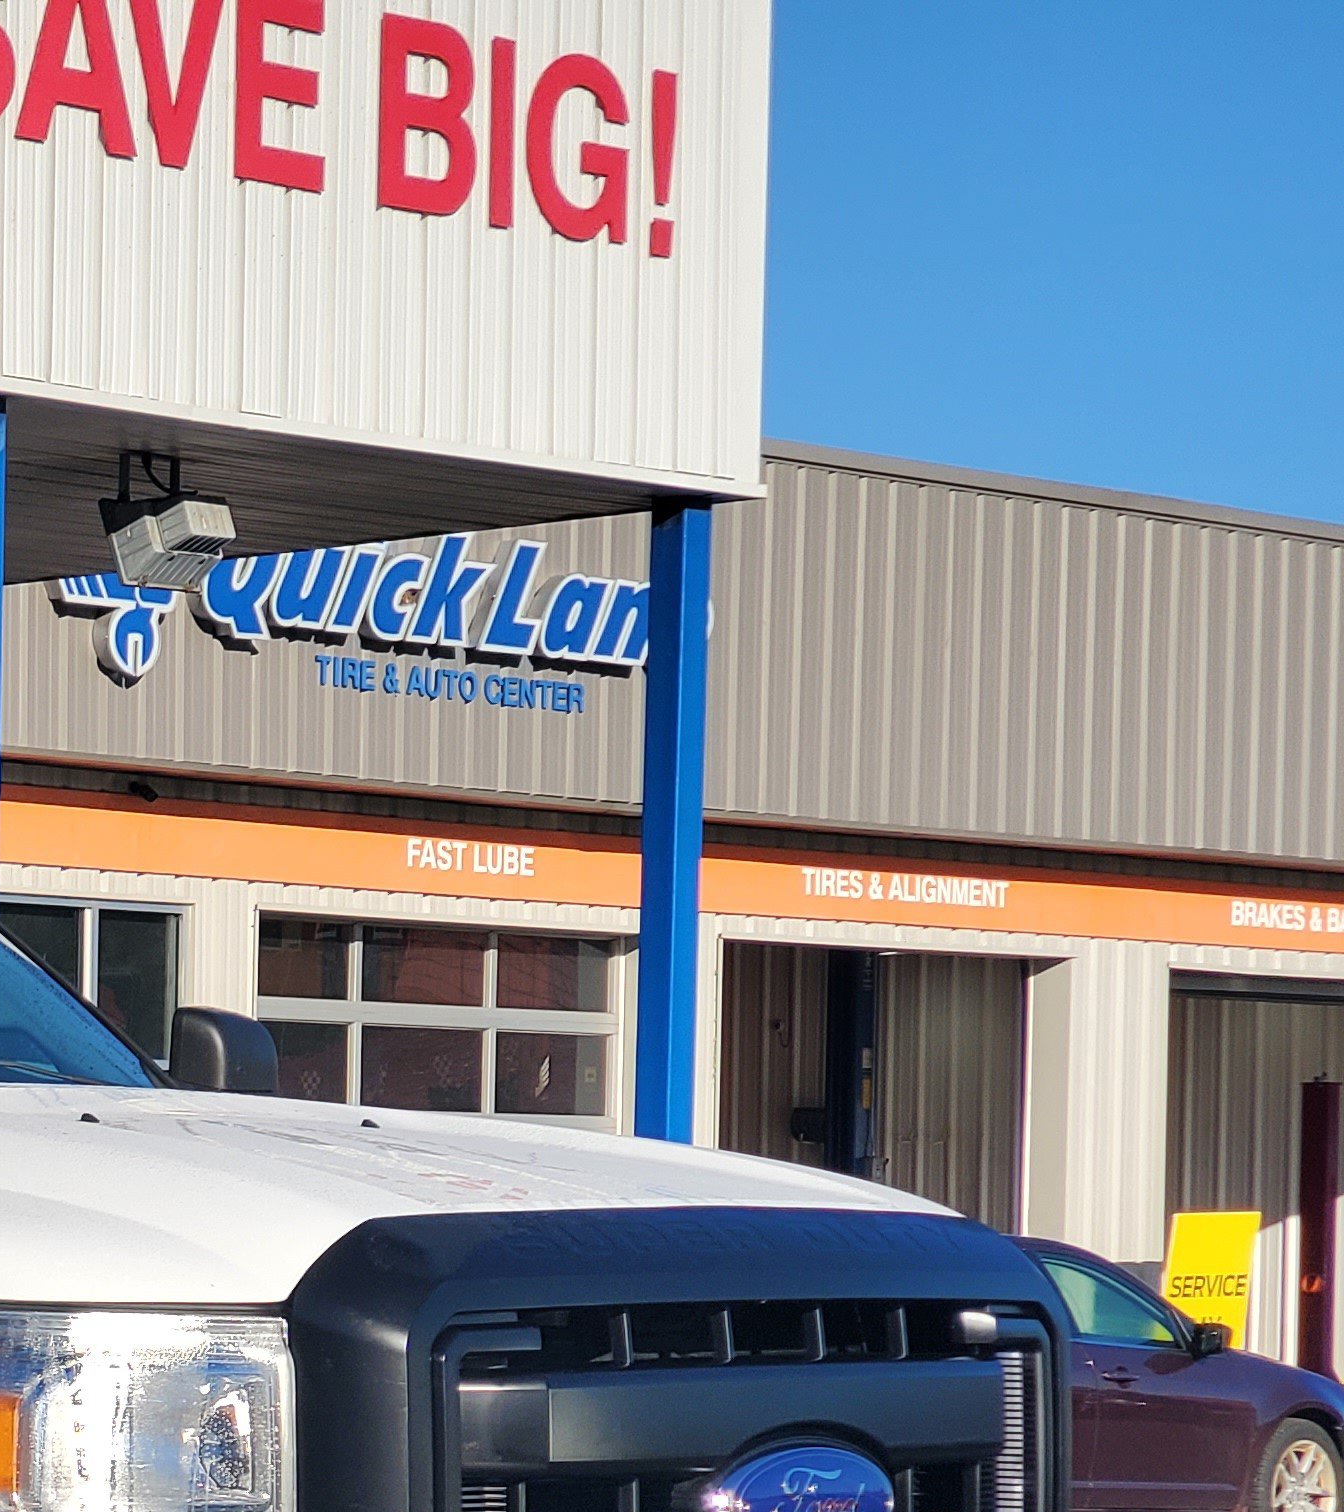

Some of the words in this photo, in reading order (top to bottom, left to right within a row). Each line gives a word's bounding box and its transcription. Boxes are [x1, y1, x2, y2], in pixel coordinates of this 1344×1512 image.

[377, 12, 679, 258] BIG!
[201, 535, 498, 648] Quick
[478, 538, 714, 667] Lan
[315, 655, 376, 692] TIRE
[382, 663, 400, 694] &
[406, 666, 479, 703] AUTO
[484, 674, 585, 713] CENTER
[407, 838, 468, 871] FAST
[473, 844, 535, 876] LUBE
[802, 868, 863, 899] TIRES
[869, 873, 884, 900] &
[888, 874, 1009, 908] ALIGNMENT
[1231, 901, 1305, 931] BRAKES
[1310, 907, 1322, 932] &
[1169, 1274, 1248, 1297] SERVICE
